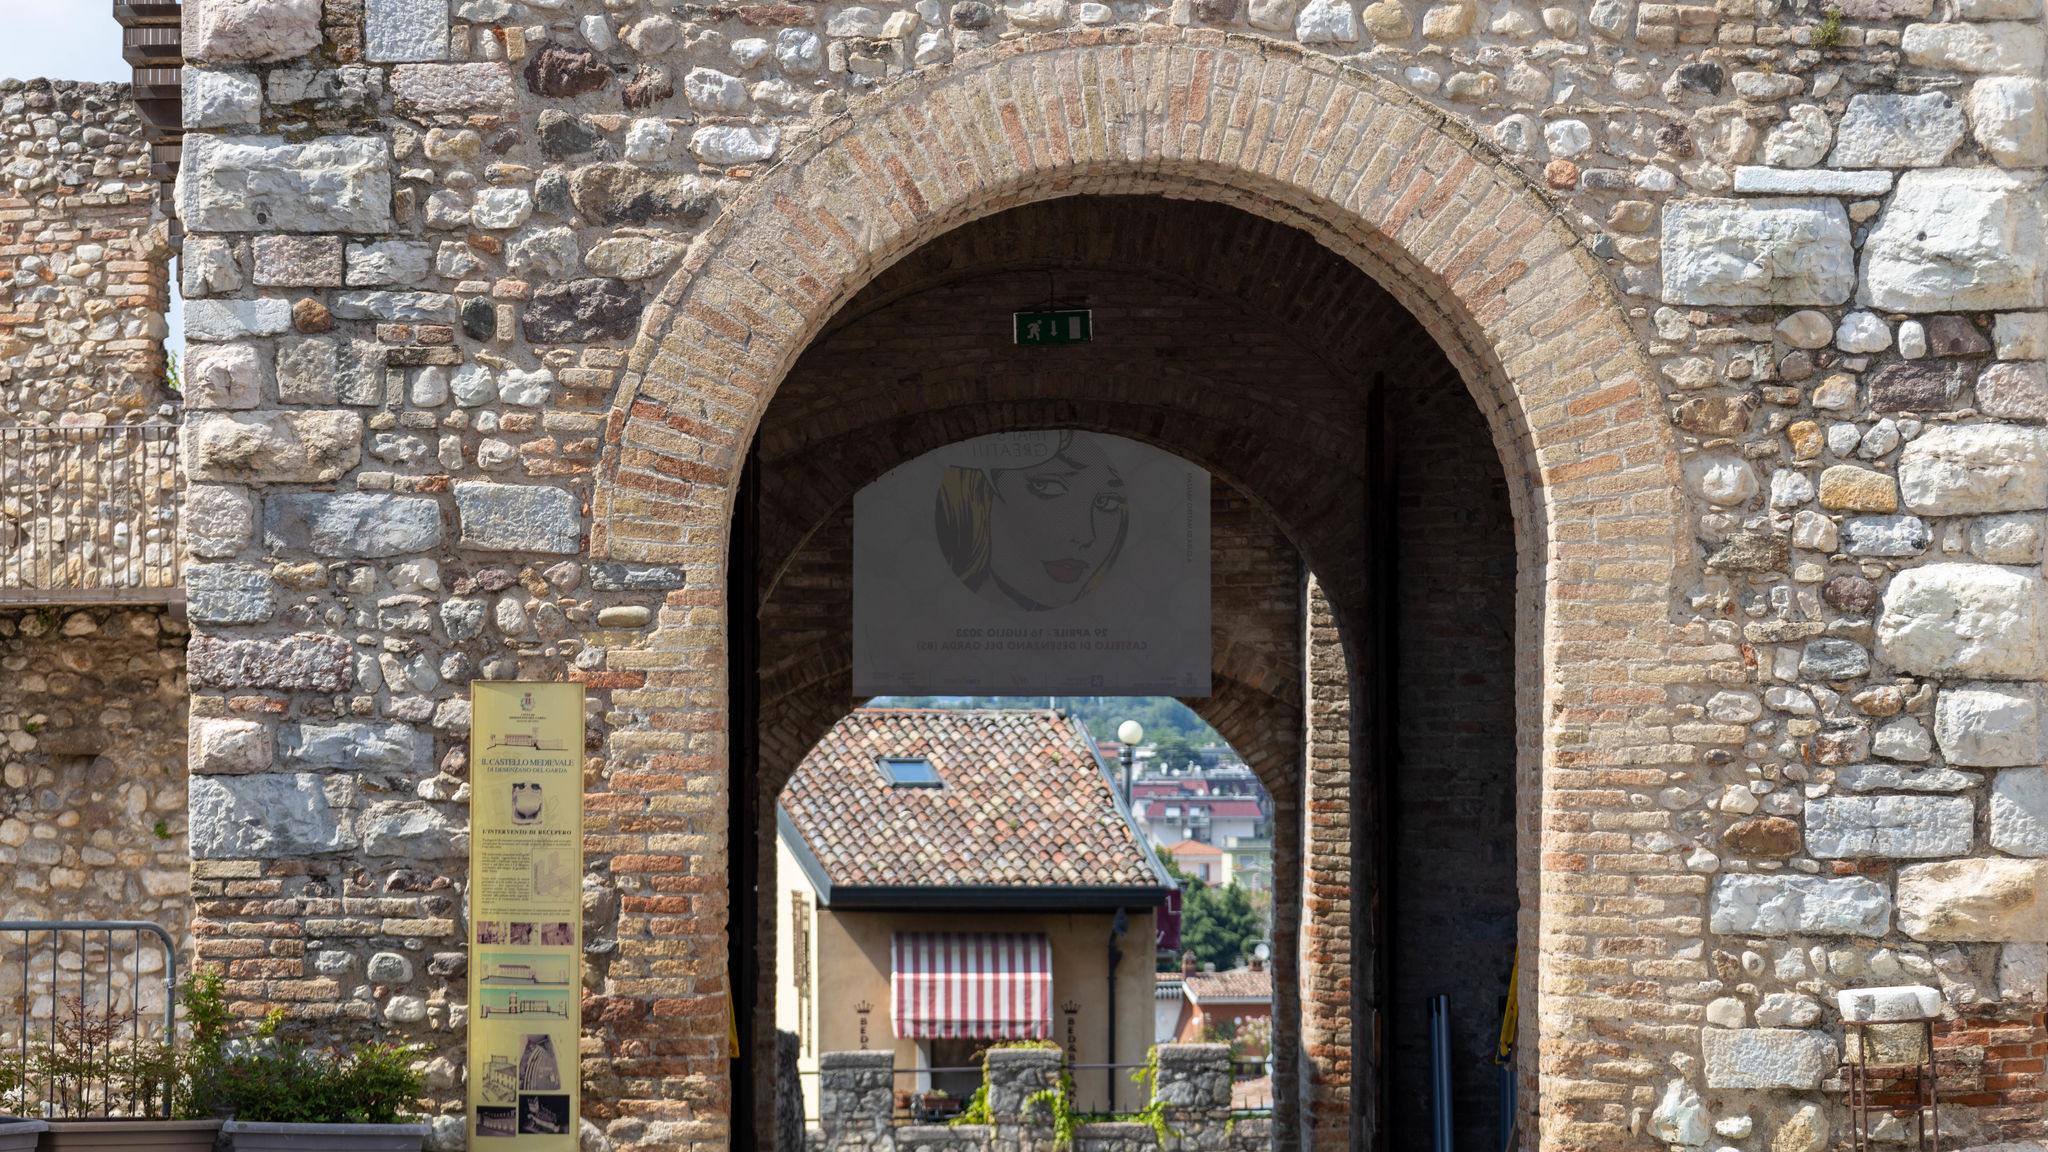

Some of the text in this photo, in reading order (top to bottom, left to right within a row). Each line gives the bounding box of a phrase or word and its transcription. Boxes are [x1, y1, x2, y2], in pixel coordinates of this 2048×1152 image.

[481, 758, 574, 767] IL CASTELLO MEDIEVALE
